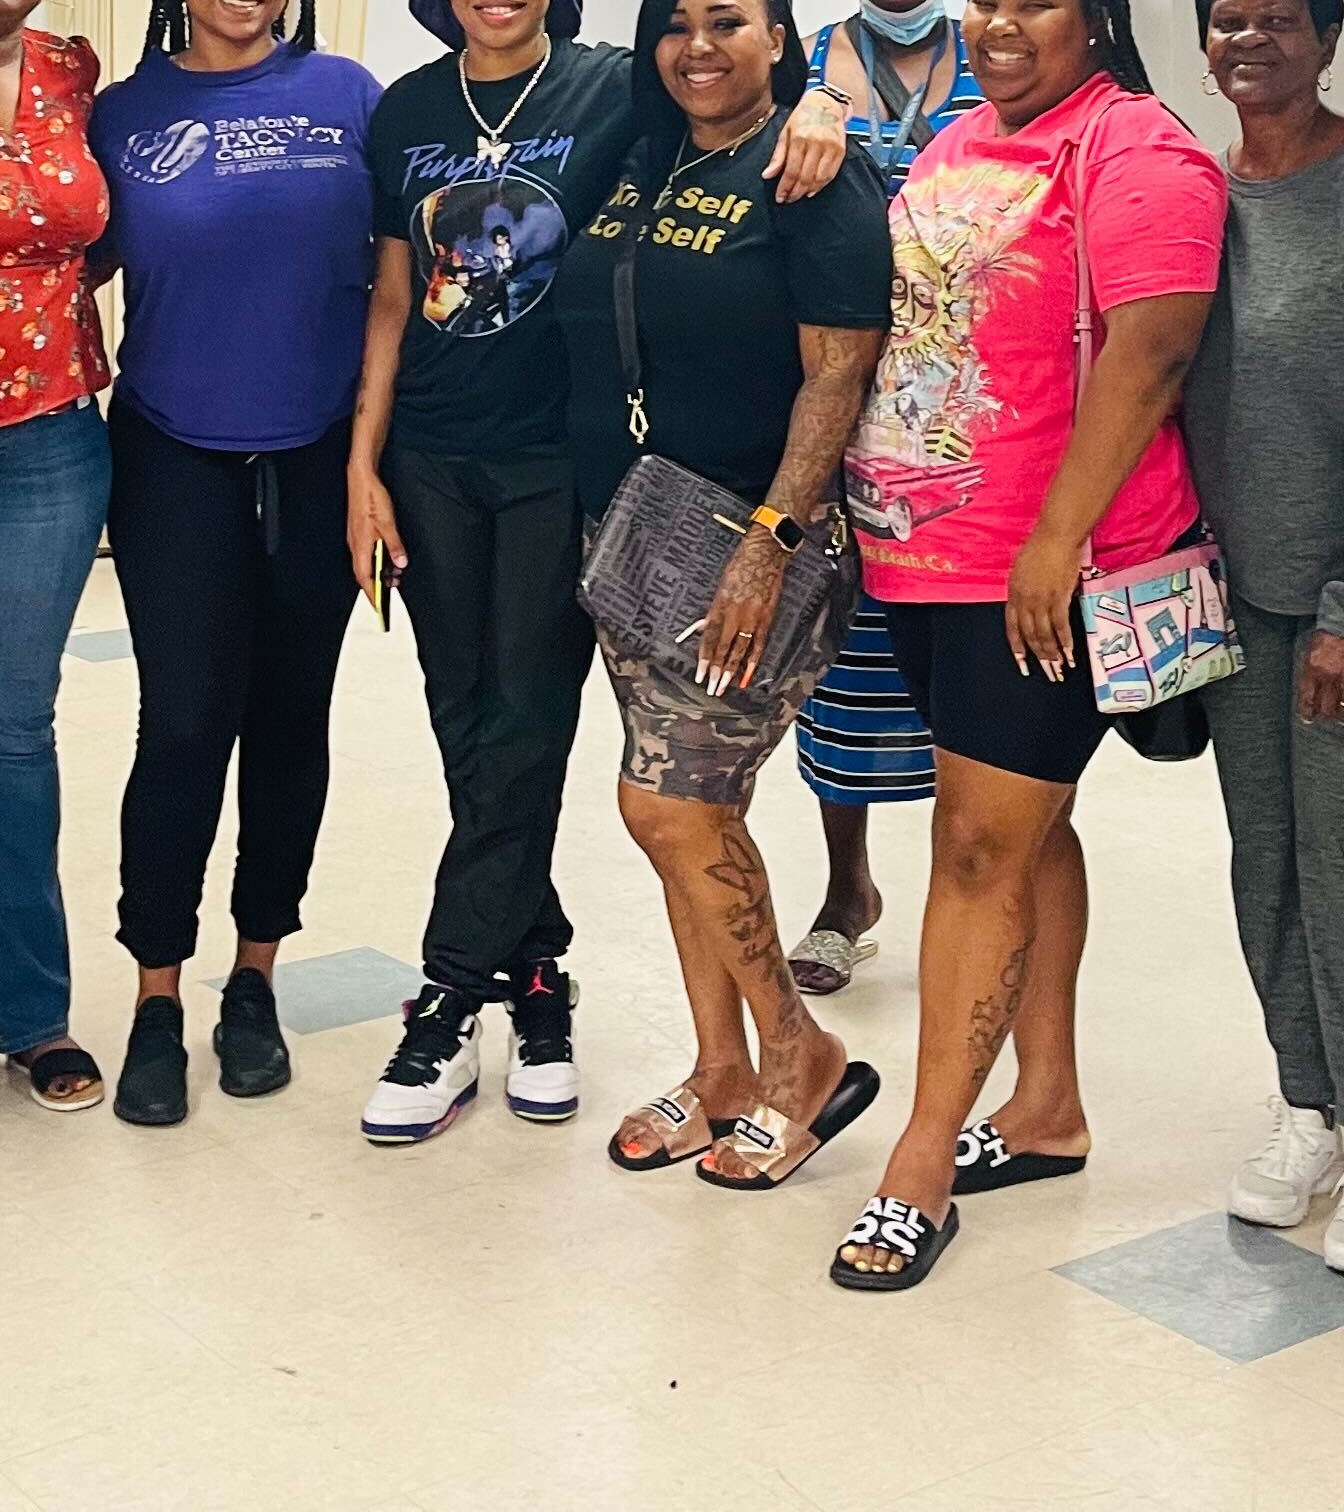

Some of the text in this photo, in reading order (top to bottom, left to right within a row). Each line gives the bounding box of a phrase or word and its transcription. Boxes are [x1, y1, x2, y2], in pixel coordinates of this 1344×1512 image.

[215, 145, 287, 161] Center
[675, 187, 753, 224] Self
[652, 217, 726, 254] Self
